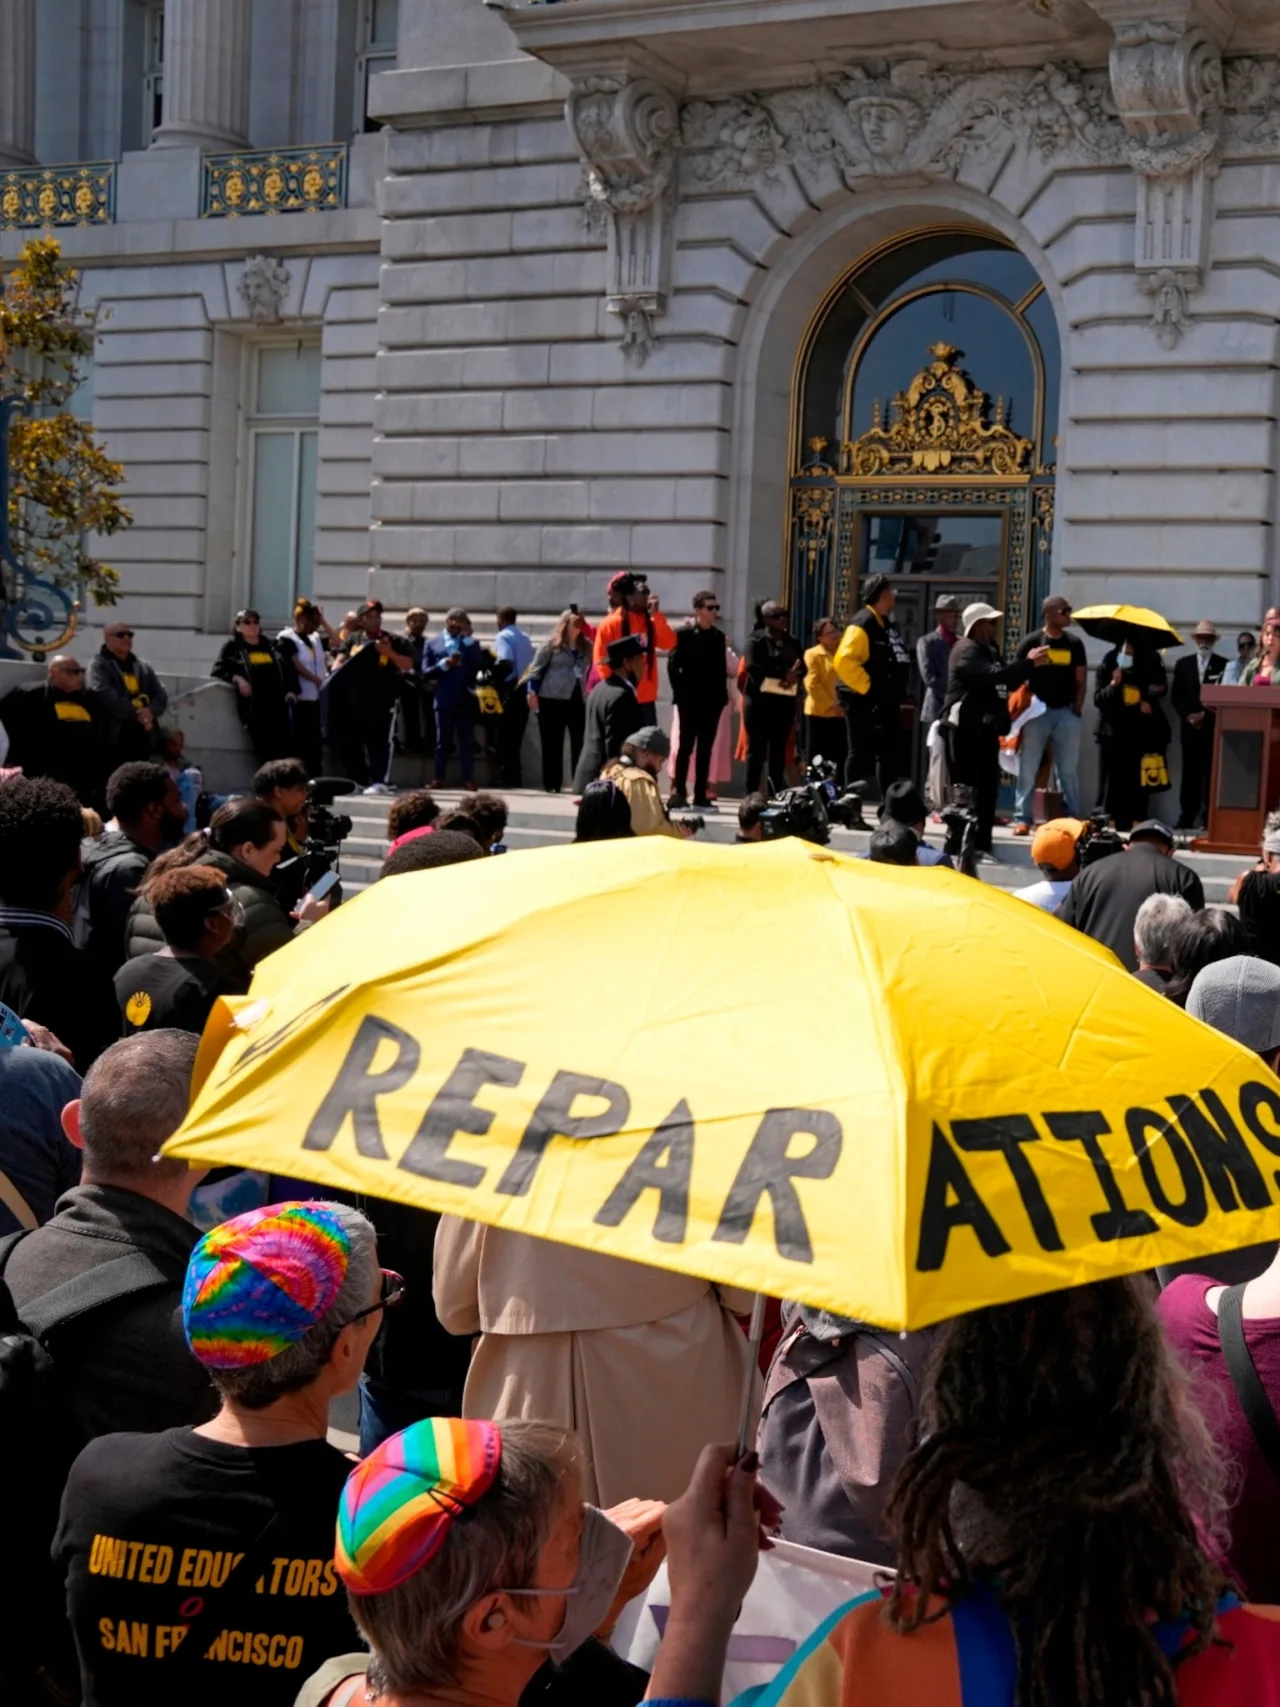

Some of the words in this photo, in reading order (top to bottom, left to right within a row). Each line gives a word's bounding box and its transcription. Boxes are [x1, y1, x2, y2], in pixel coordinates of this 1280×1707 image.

[89, 1533, 174, 1585] UNITED
[177, 1547, 338, 1597] EDUTORS
[99, 1616, 149, 1658] SAN
[155, 1624, 304, 1669] FRNCISCO
